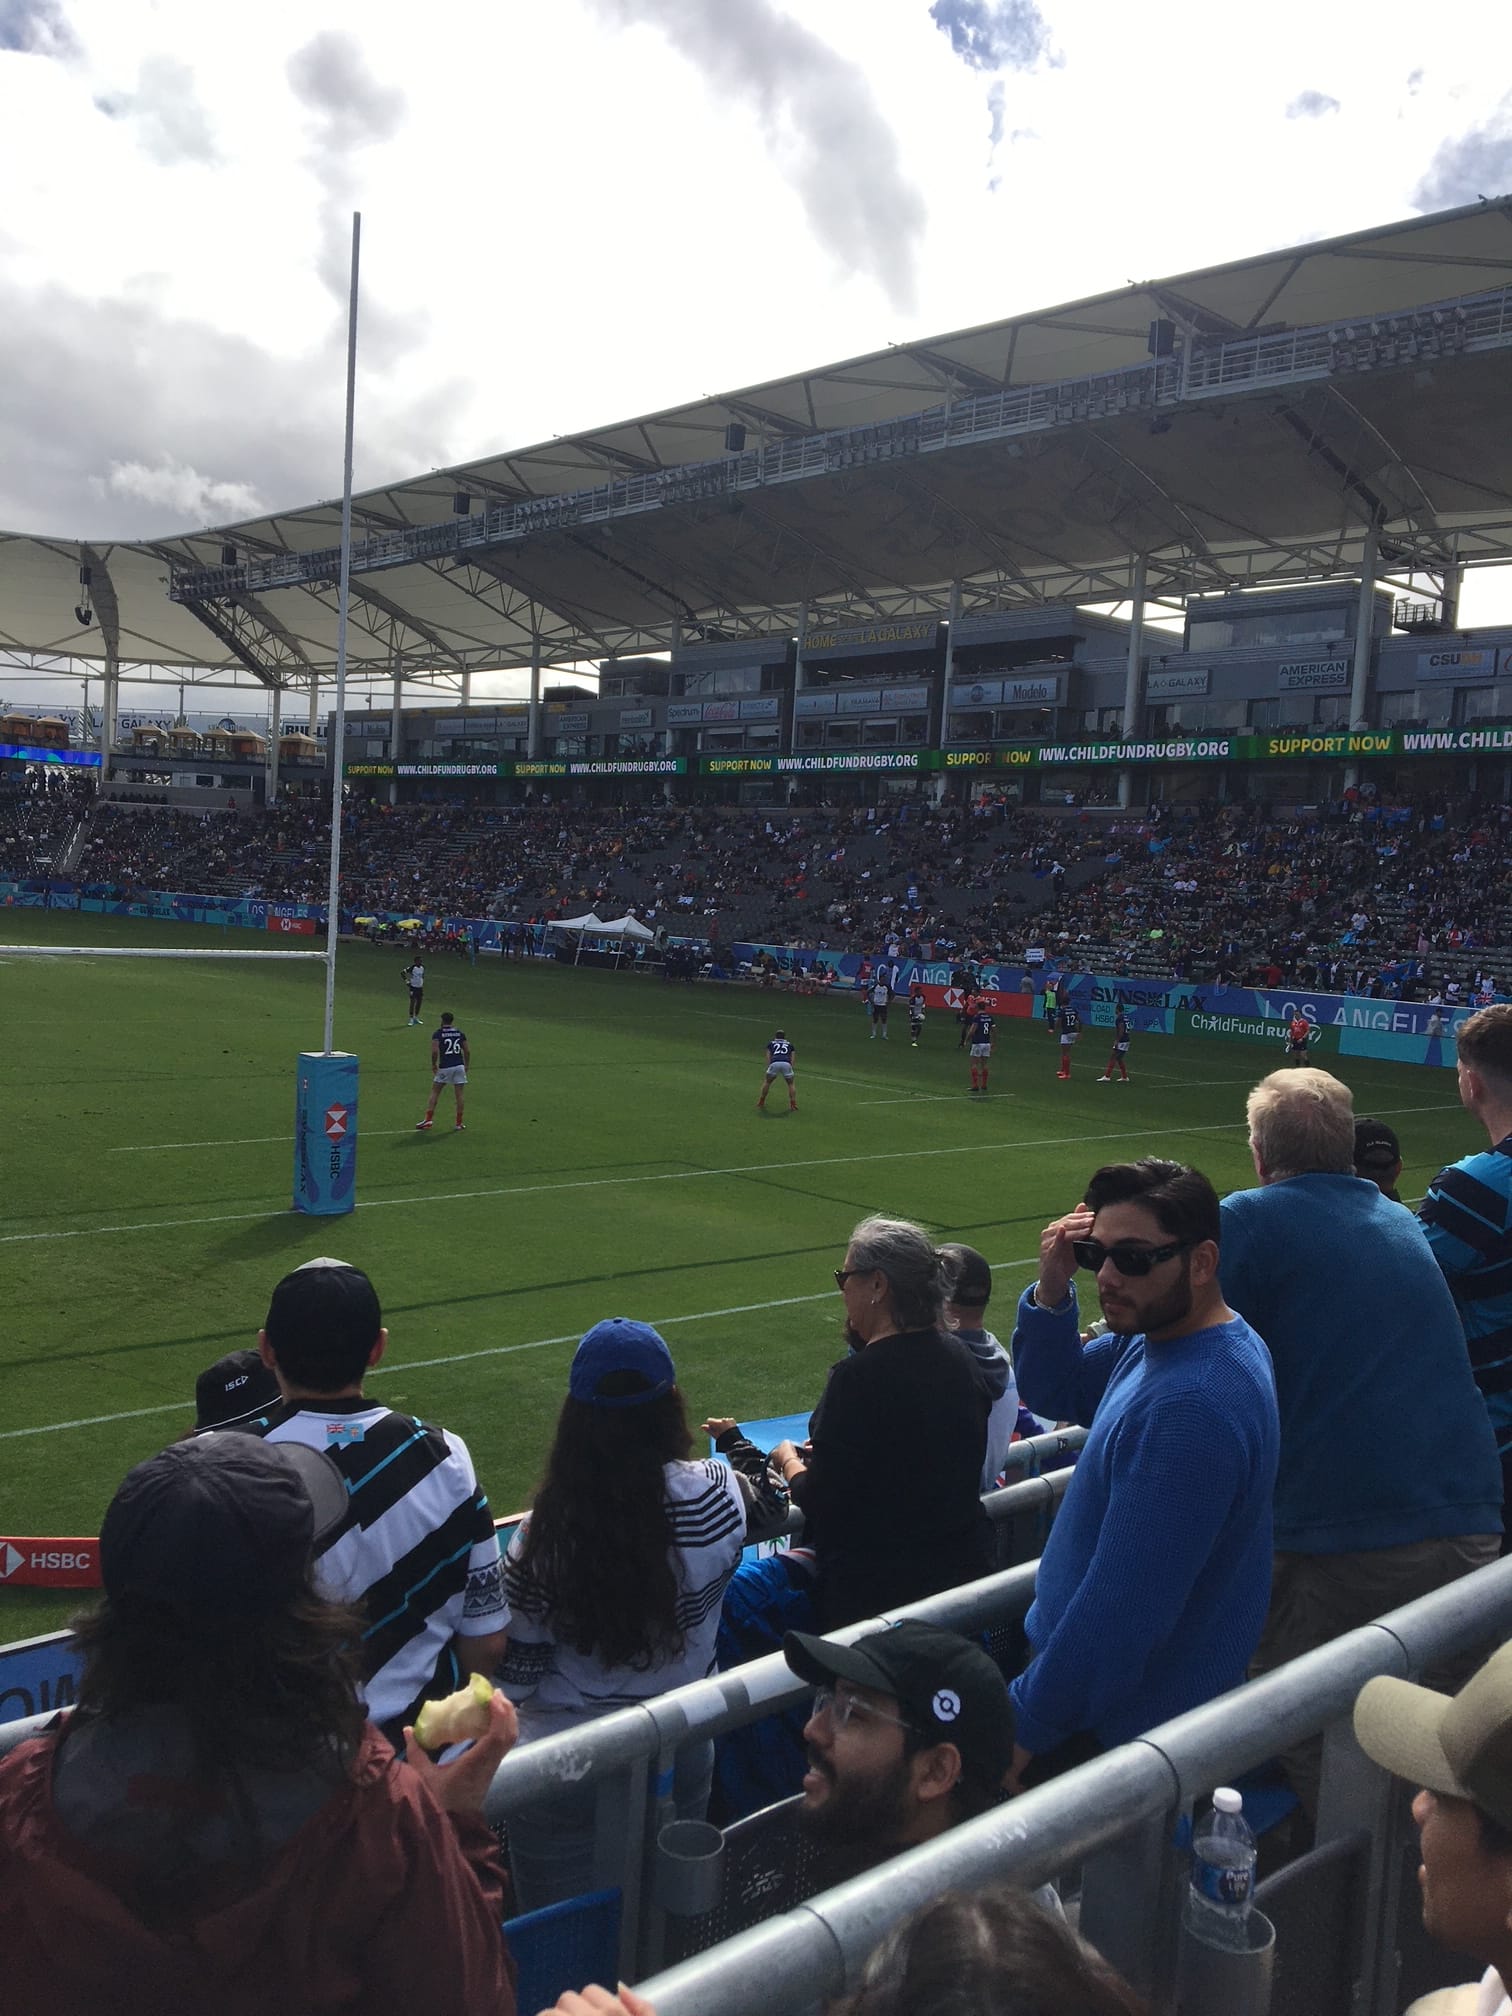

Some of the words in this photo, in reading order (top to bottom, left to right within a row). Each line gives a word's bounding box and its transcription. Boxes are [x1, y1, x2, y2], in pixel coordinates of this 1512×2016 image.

[804, 635, 838, 649] HOME
[879, 624, 930, 641] GALAXY
[1280, 662, 1345, 676] AMERICAN
[1147, 679, 1160, 690] LA
[1168, 676, 1207, 688] GALAXY
[1288, 674, 1345, 686] EXPRESS
[1013, 683, 1048, 700] Modelo
[668, 706, 700, 718] Spectrum
[121, 718, 172, 730] GALXY
[1269, 737, 1345, 754] SUPPORT
[1348, 736, 1391, 751] NOW
[946, 752, 993, 765] SUPPOR
[1038, 741, 1229, 761] WW.CHILDFUNDRUGBY.ORG
[347, 764, 376, 775] SUPPORT
[377, 764, 394, 775] NOW
[397, 764, 497, 775] WWW.CHILDFUNDRUGBY.ORG
[515, 763, 549, 775] SUPPORT
[549, 763, 566, 774] NOW
[570, 761, 677, 774] WWW.CHILDFUNDRUGBY.ORG
[709, 759, 749, 772] SUPPORT
[750, 759, 772, 770] NOW
[777, 754, 918, 770] WWW.CHILDFUNDRUGBY.ORG
[274, 907, 308, 918] NGELES
[1165, 993, 1207, 1012] LAX
[1066, 1014, 1077, 1027] 12
[1191, 1013, 1265, 1036] ChildFund
[983, 1022, 990, 1036] 8
[444, 1038, 461, 1055] 26
[773, 1043, 789, 1055] 25
[330, 1145, 341, 1180] HSBC
[30, 1552, 91, 1570] HSBC
[1226, 1870, 1249, 1881] Pure
